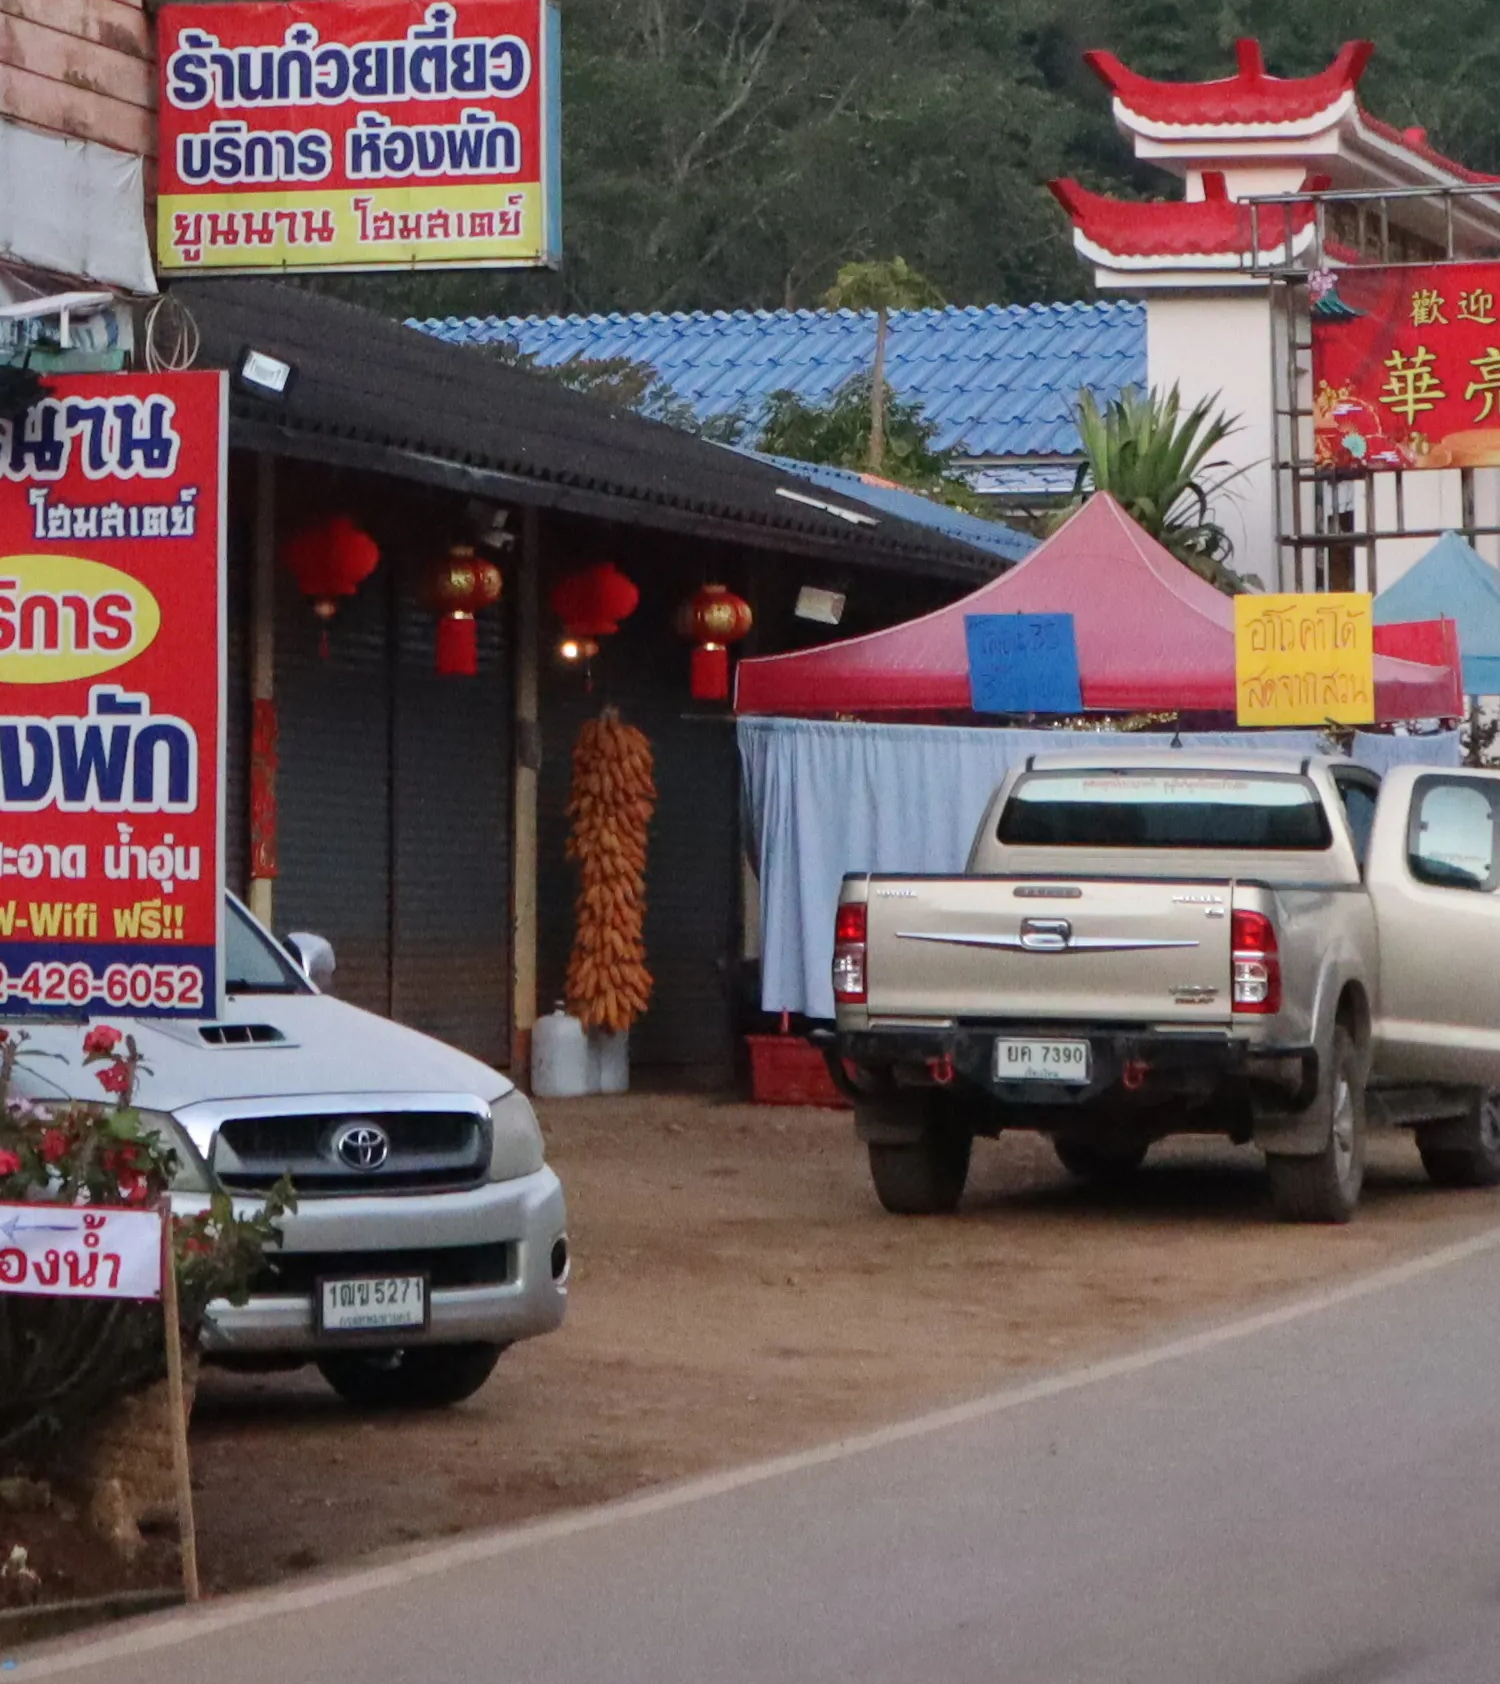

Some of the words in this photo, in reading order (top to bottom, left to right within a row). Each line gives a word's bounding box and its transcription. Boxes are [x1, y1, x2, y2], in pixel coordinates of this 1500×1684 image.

[169, 4, 529, 104] ร้านก๋วยเตี๋ยว
[180, 121, 328, 180] บริการ
[352, 113, 518, 173] ห้องพัก
[173, 203, 334, 261] ยูนนาน
[356, 195, 523, 242] โฮมสเตย์
[29, 487, 197, 539] โฮมสเตย์
[104, 822, 200, 893] น้ำอุ่น
[114, 899, 184, 939] ฟรี!!
[1041, 1046, 1083, 1064] 7390
[374, 1279, 422, 1304] 5271
